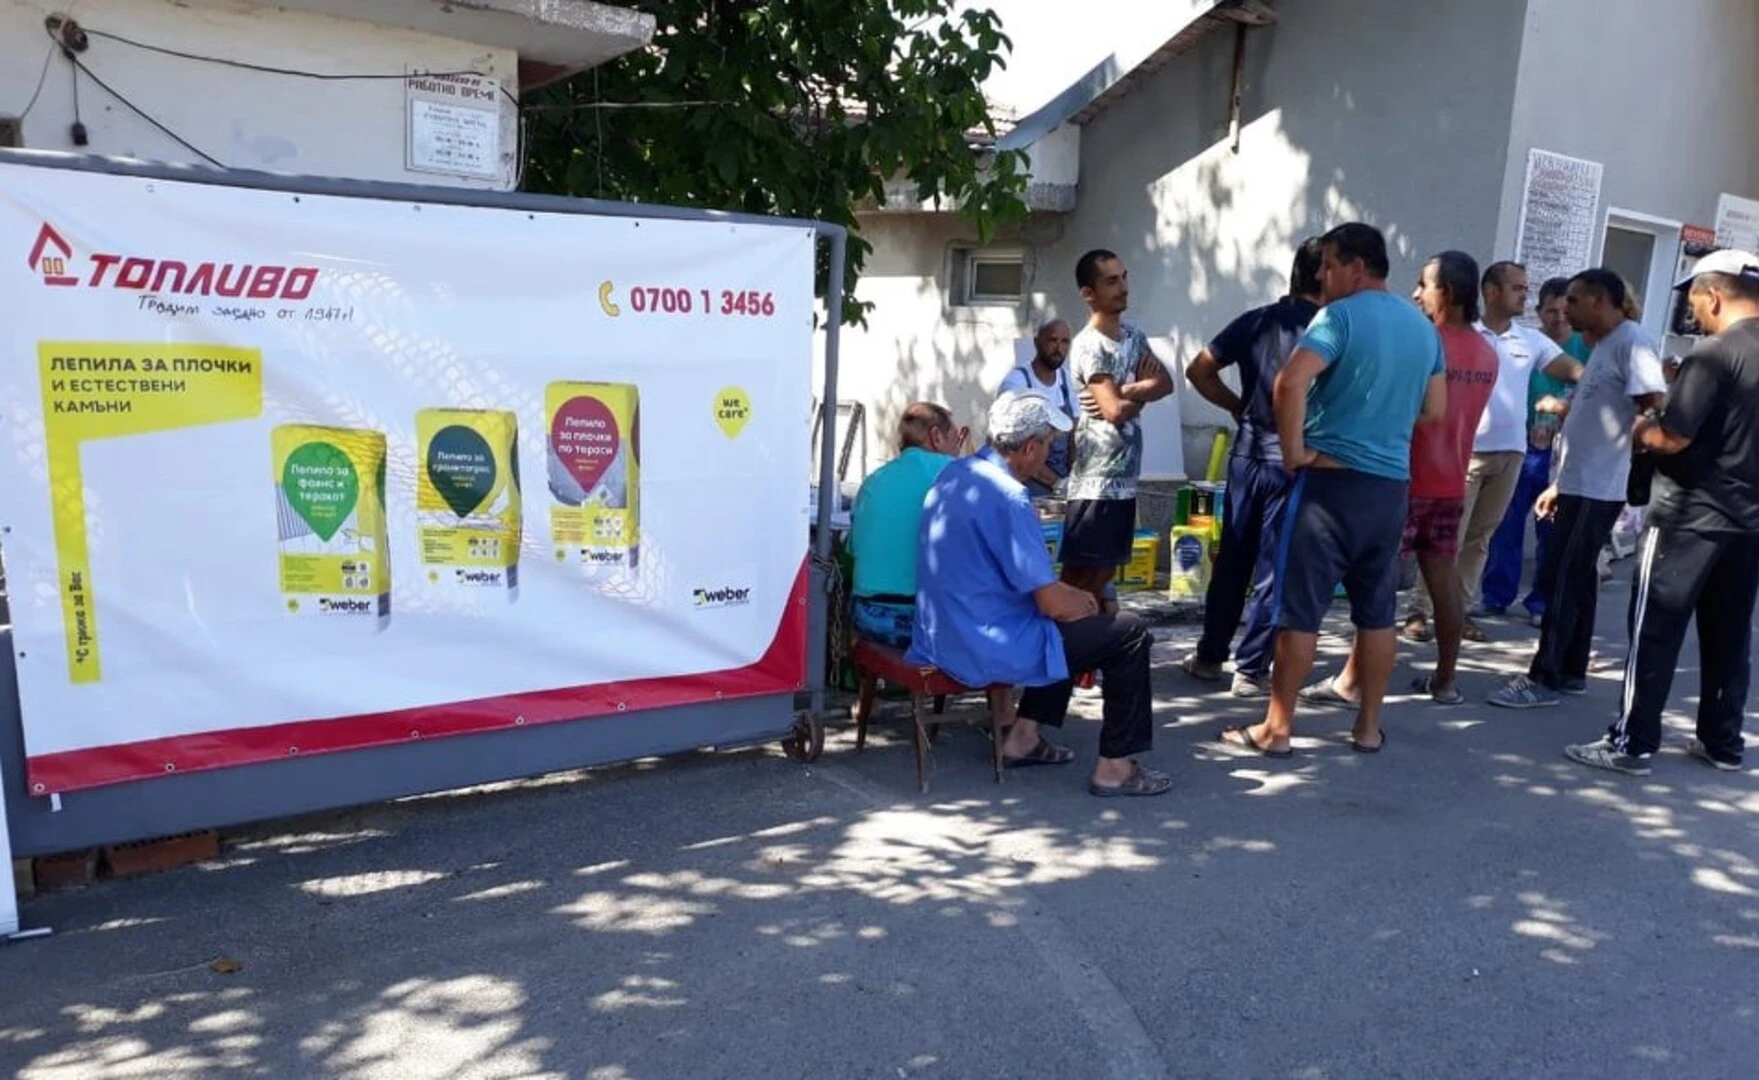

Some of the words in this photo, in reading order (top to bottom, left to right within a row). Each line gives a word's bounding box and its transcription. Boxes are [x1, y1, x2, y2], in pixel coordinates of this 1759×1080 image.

[88, 253, 319, 300] ТОПЛИВО
[630, 286, 693, 313] 0700
[700, 289, 711, 314] 1
[720, 289, 776, 317] 3456
[276, 307, 295, 319] от
[51, 357, 137, 372] ЛЕПИЛА
[142, 358, 169, 372] ЗА
[172, 358, 253, 374] ПЛОЧКИ
[52, 379, 65, 392] И
[70, 379, 186, 393] ЕСТЕСТВЕНИ
[53, 400, 133, 414] КАМЪНИ
[722, 398, 741, 408] we
[565, 416, 607, 429] Лепило
[560, 431, 573, 441] за
[573, 432, 613, 443] плочки
[437, 451, 473, 463] Лепило
[474, 453, 486, 463] за
[558, 444, 573, 455] по
[575, 445, 614, 457] тераси
[291, 463, 334, 476] Лепило
[336, 466, 350, 477] за
[299, 492, 346, 503] теракот
[464, 569, 502, 582] weber
[703, 586, 750, 603] weber
[329, 597, 371, 611] weber
